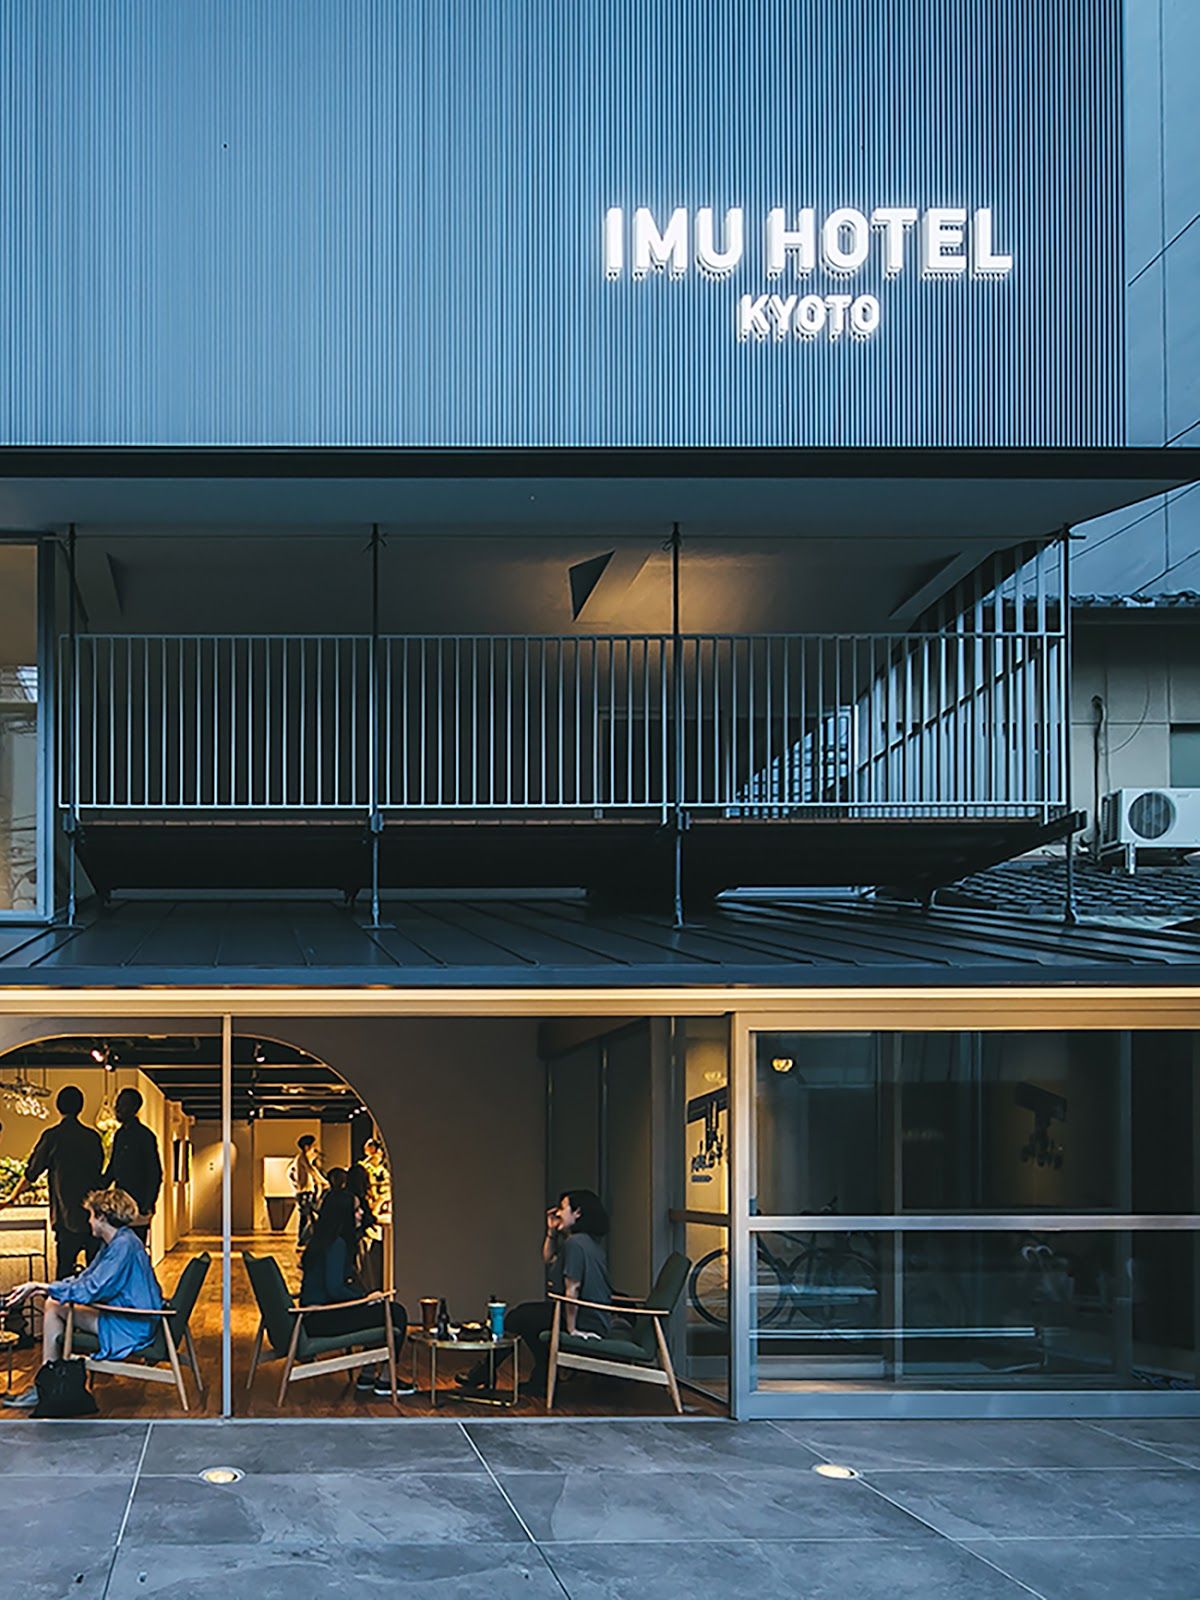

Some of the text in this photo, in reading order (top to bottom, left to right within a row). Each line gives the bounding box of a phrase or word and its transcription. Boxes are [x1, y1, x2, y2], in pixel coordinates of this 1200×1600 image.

[604, 206, 1014, 279] IMU HOTEL
[738, 293, 881, 340] KYOTO
